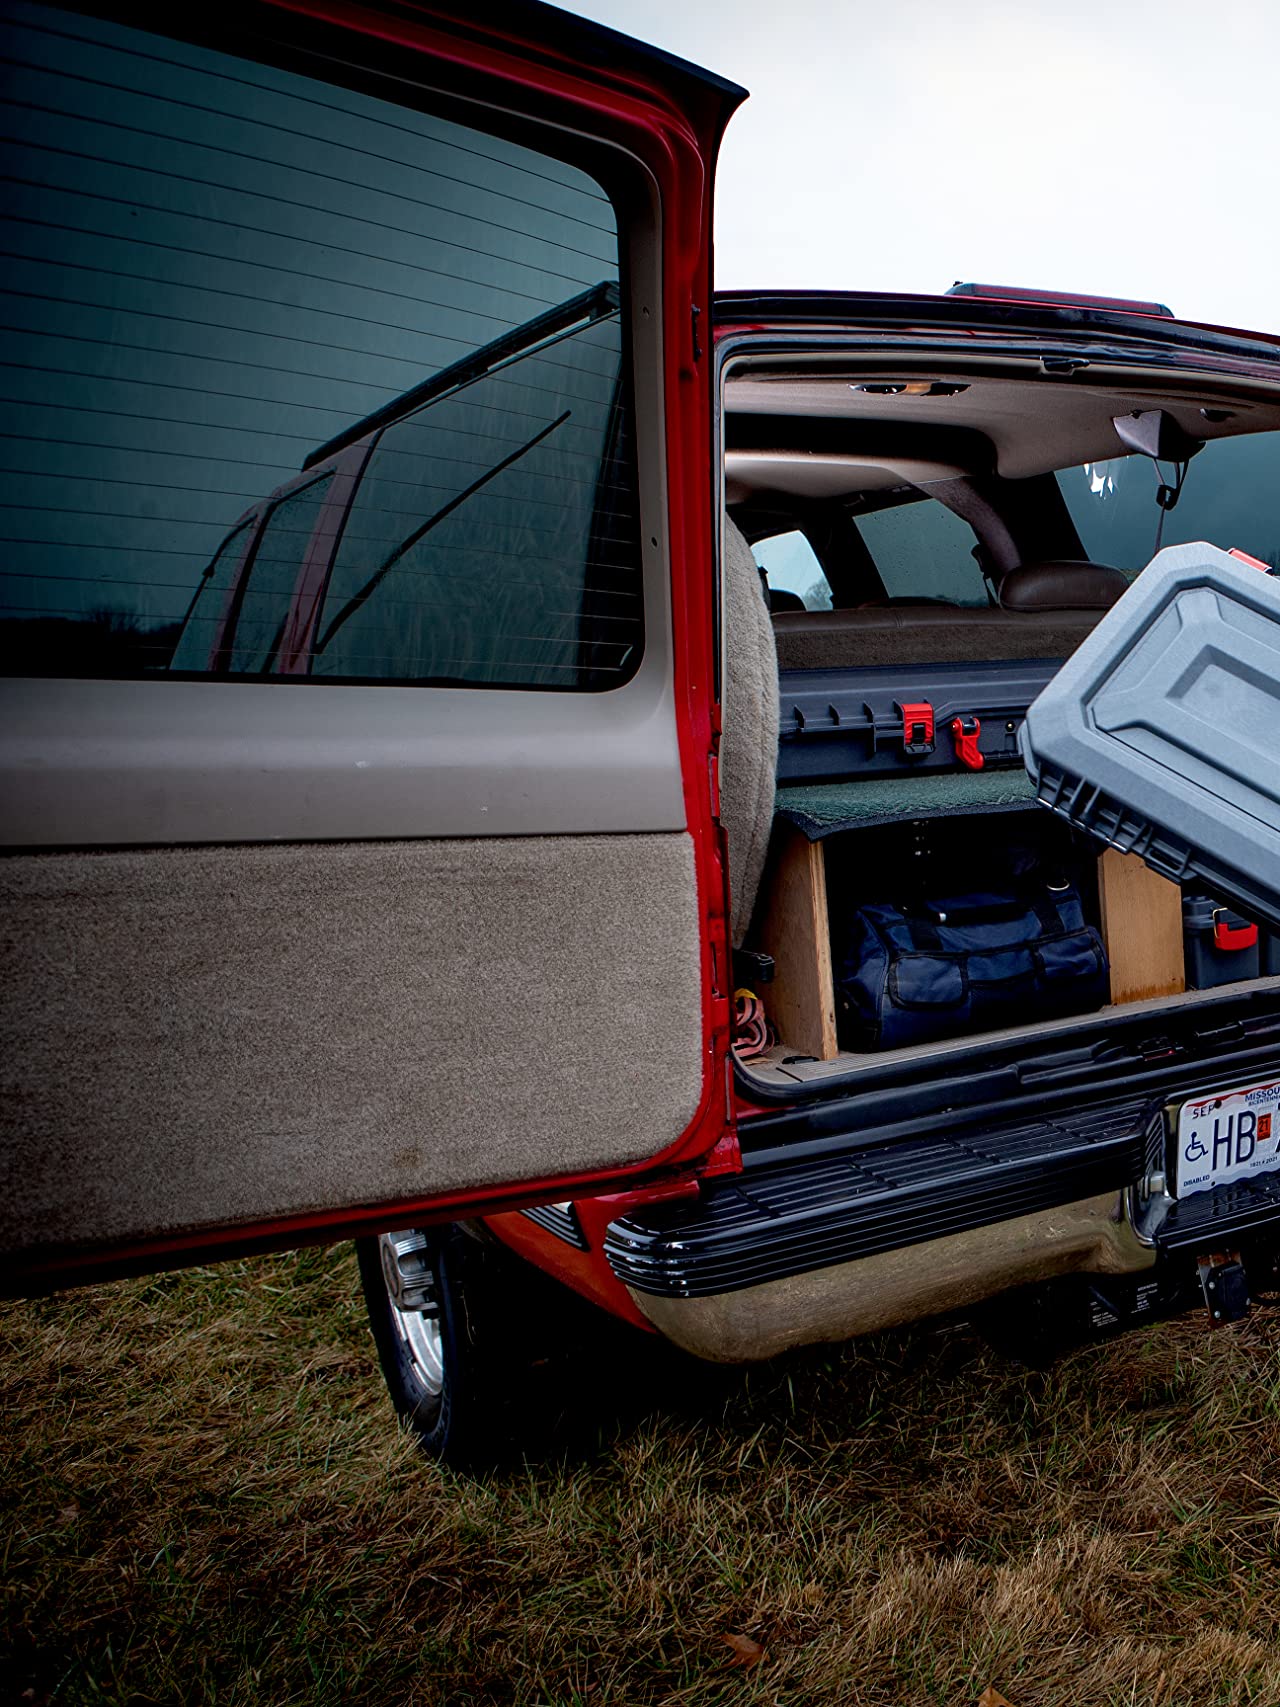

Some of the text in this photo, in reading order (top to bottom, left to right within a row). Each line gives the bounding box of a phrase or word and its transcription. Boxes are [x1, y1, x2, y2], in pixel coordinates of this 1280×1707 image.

[1192, 1104, 1215, 1119] SEP
[1258, 1120, 1268, 1132] 21
[1212, 1110, 1257, 1171] HB
[1183, 1174, 1210, 1187] DISABLED
